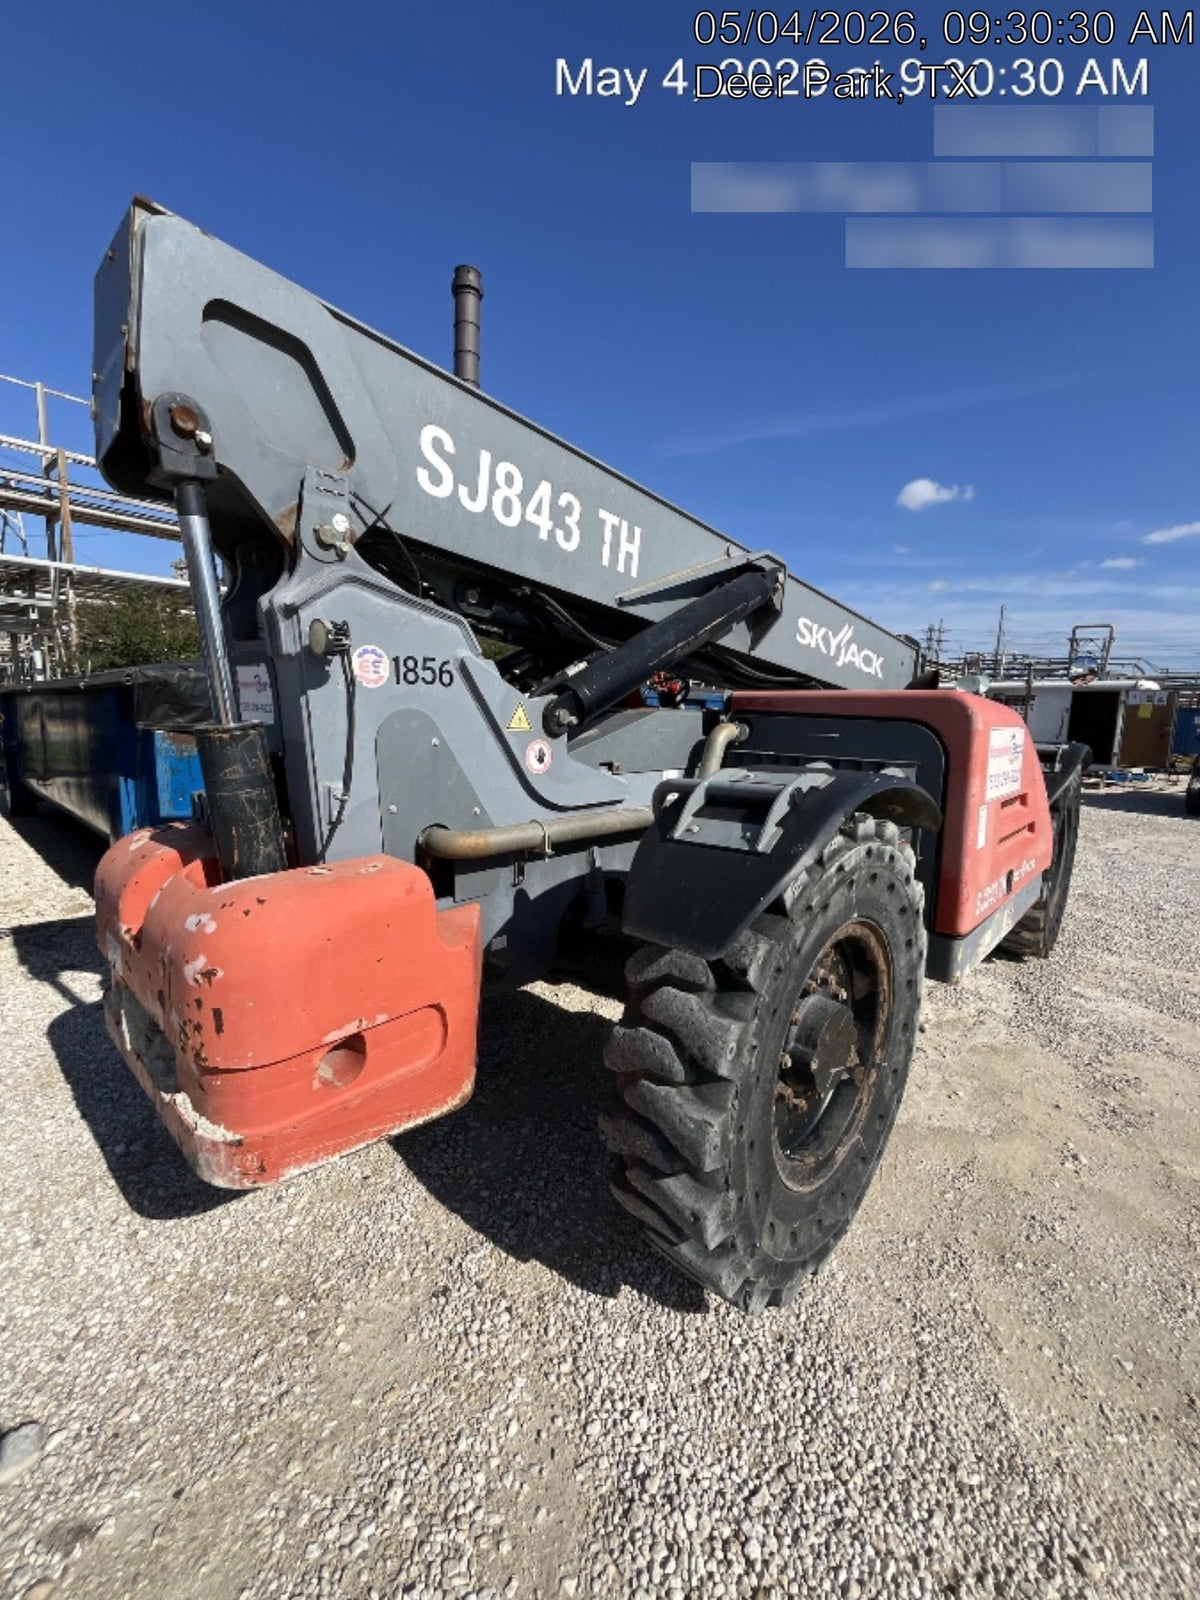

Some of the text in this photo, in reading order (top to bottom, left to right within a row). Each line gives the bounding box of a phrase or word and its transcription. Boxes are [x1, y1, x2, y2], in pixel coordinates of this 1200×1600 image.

[416, 424, 642, 578] SJ843 TH
[392, 655, 454, 688] 1856
[796, 617, 884, 678] SKYJACK
